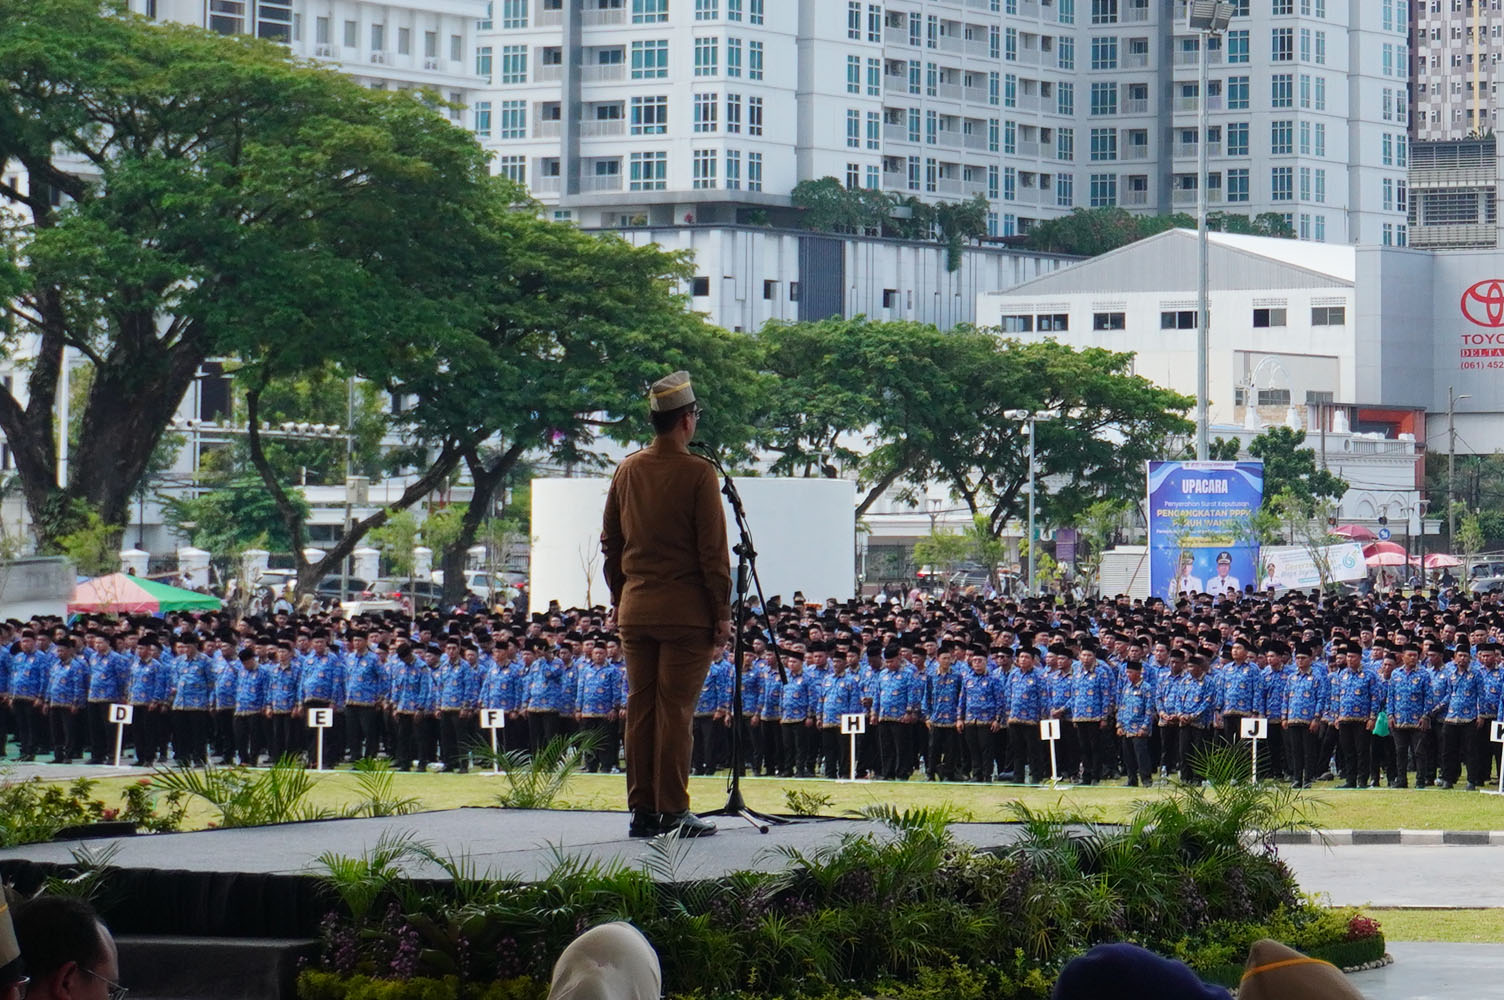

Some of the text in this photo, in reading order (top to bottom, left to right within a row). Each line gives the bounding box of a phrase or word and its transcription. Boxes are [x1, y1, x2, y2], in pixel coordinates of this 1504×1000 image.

[1460, 361, 1485, 370] (061)
[1181, 479, 1229, 494] UPACARA
[1164, 501, 1200, 509] Penyerahan
[1218, 501, 1250, 509] Keputusan
[115, 706, 127, 721] D
[315, 710, 326, 726] E
[487, 710, 497, 726] F
[847, 716, 860, 732] H
[1048, 721, 1053, 738] I
[1247, 720, 1260, 737] J
